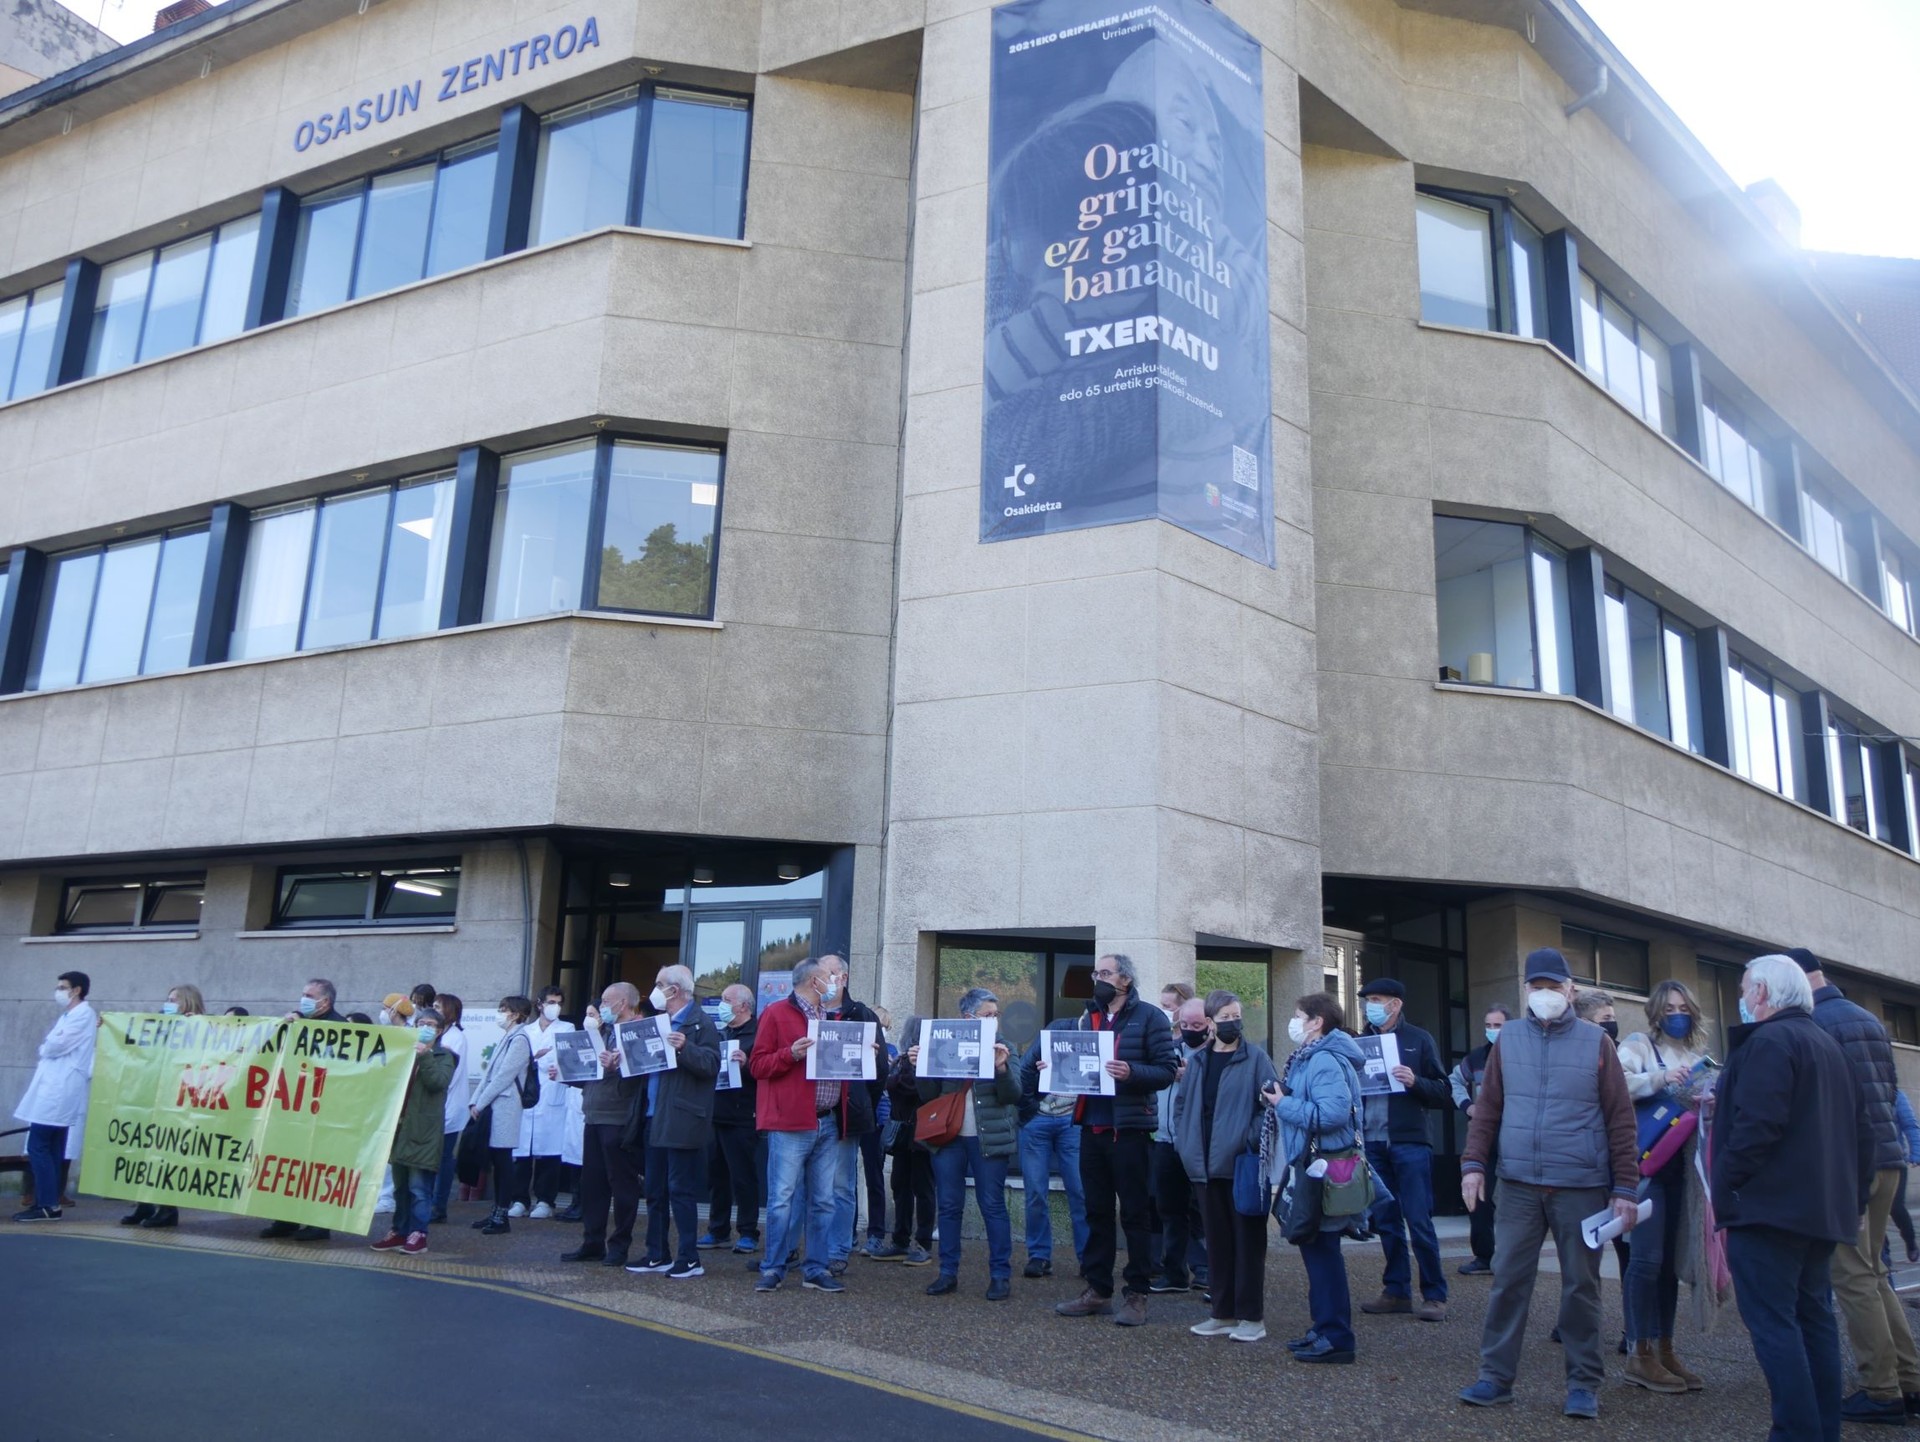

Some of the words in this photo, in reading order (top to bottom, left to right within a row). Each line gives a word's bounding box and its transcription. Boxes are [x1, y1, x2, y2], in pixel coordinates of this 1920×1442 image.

[1009, 33, 1057, 54] 2021EKO
[1059, 15, 1119, 39] GRIPEAREN
[1102, 23, 1144, 41] Urriaren
[294, 79, 422, 153] OSASUN
[437, 16, 600, 102] ZENTROA
[1084, 139, 1197, 197] Orain,
[1077, 177, 1212, 239] gripeak
[1044, 236, 1090, 268] ez
[1102, 211, 1231, 289] gaitzala
[1063, 259, 1220, 321] banandu
[1065, 315, 1219, 371] TXERTATU
[1059, 388, 1083, 402] edo
[1085, 384, 1101, 397] 65
[1103, 375, 1142, 394] urtetik
[1144, 376, 1185, 397] gorakoei
[1186, 392, 1223, 418] zuzendua
[1114, 362, 1188, 387] Arrisku-taldeei
[1003, 501, 1062, 517] Osakidetza
[125, 1017, 198, 1051] LEHEN
[294, 1025, 387, 1066] ARRETA
[621, 1030, 639, 1042] Nik
[820, 1030, 840, 1041] Nik
[933, 1028, 953, 1040] Nik
[1053, 1041, 1073, 1053] Nik
[108, 1118, 255, 1163] OSASUNGINTZA
[113, 1156, 246, 1199] PUBLIKOAREN
[248, 1153, 362, 1209] DEFENTSAN
